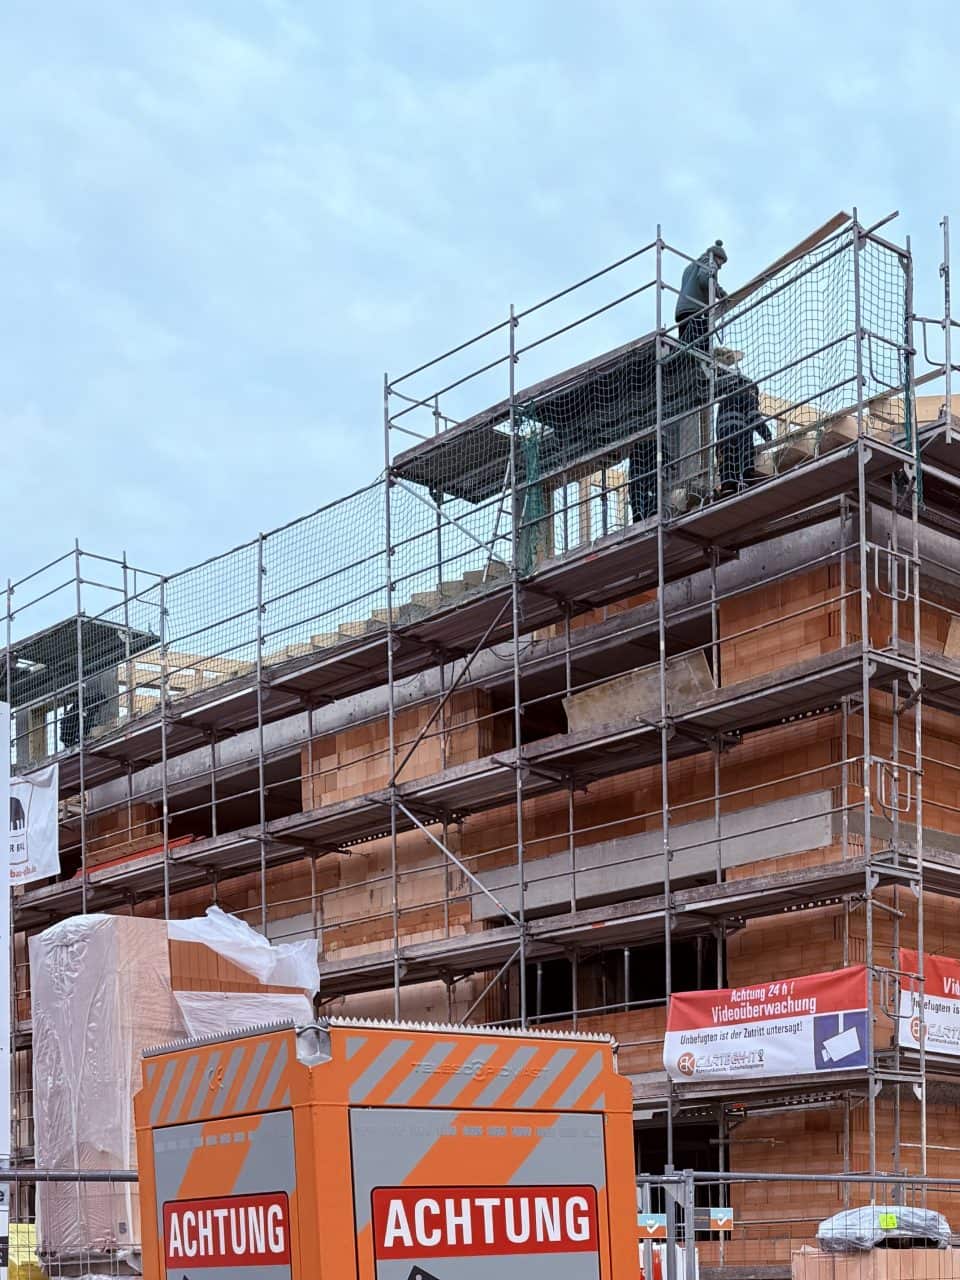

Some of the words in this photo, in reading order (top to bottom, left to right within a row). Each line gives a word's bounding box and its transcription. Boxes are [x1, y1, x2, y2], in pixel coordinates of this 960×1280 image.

[731, 988, 765, 1003] Achtung
[768, 984, 780, 997] 24
[712, 997, 816, 1024] Videoüberwachung
[680, 1030, 717, 1045] Unbefugten
[719, 1029, 729, 1040] ist
[730, 1027, 742, 1039] der
[743, 1026, 765, 1038] Zutritt
[169, 1204, 285, 1257] ACHTUNG
[383, 1196, 590, 1248] ACHTUNG
